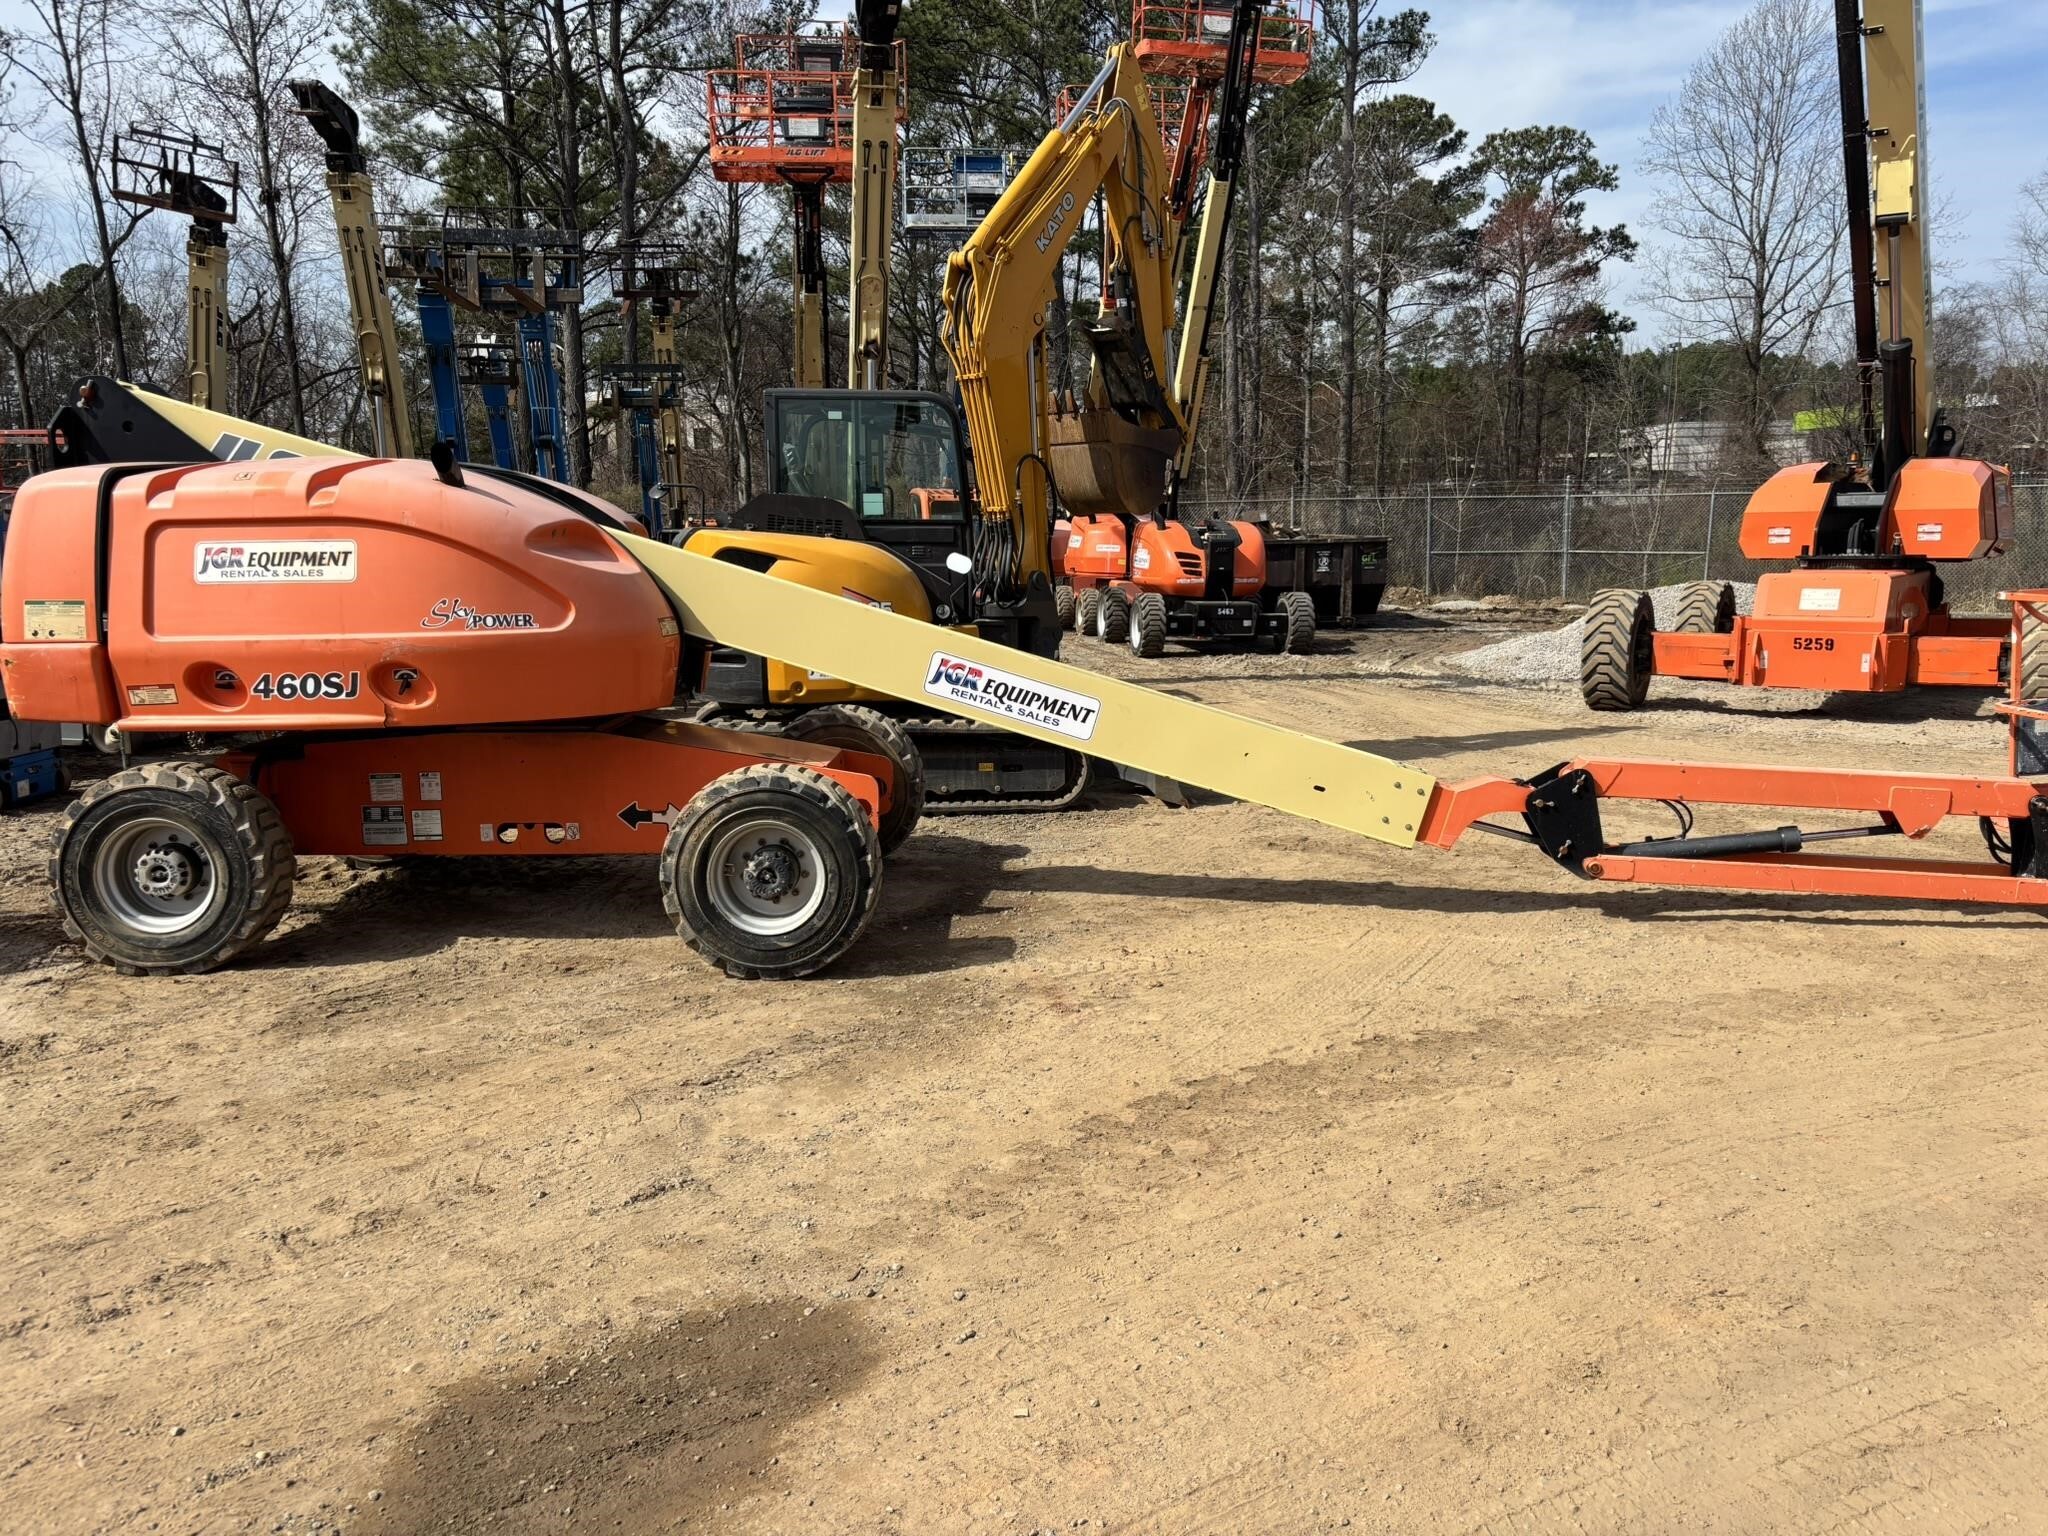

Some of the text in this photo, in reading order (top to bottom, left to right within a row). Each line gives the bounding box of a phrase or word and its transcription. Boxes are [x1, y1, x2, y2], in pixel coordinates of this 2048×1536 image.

[785, 148, 826, 156] JLG LIFT
[1035, 192, 1075, 254] KATO
[198, 547, 352, 574] JGR EQUIPMENT
[220, 569, 324, 578] RENTAL & SALES
[472, 613, 535, 628] POWER
[1793, 637, 1835, 651] 5259
[252, 671, 360, 700] 460SJ
[928, 658, 1095, 724] JGR EQUIPMENT
[950, 687, 1060, 727] RENTAL & SALES
